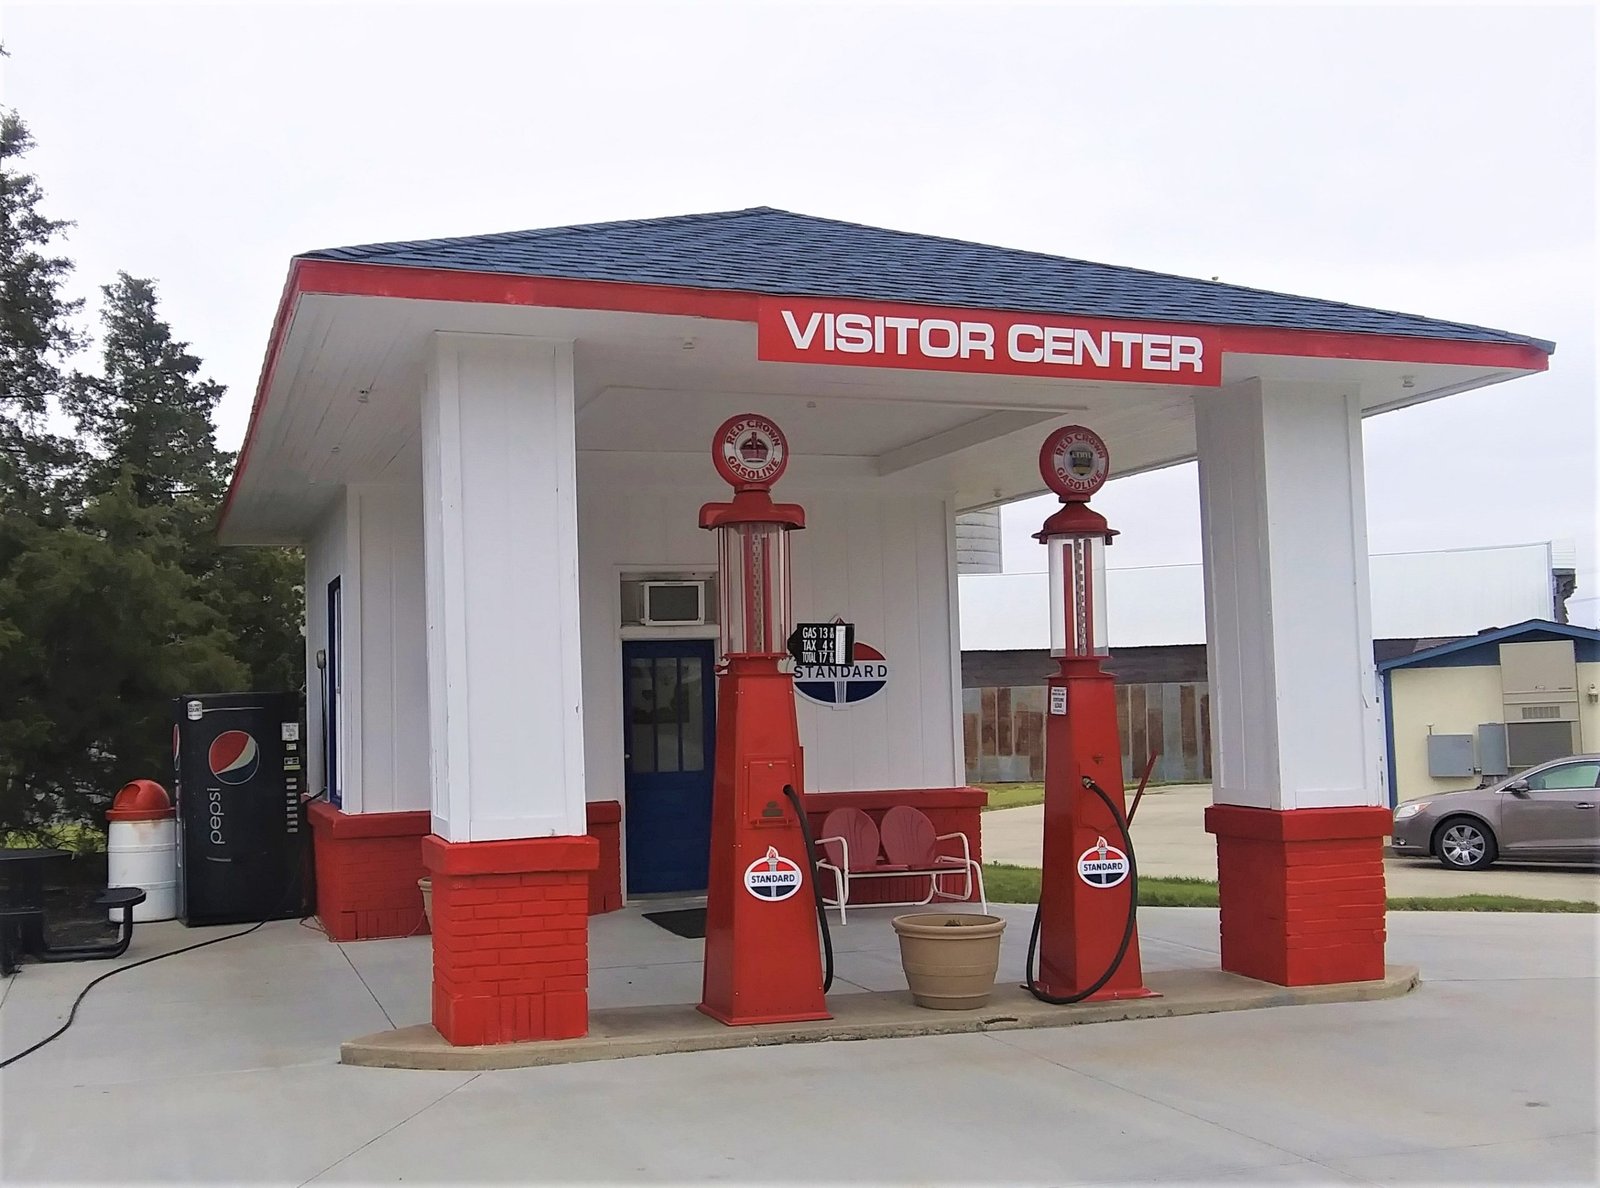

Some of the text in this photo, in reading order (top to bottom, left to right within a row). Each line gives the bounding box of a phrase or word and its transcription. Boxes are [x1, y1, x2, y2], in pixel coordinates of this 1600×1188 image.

[781, 310, 1204, 372] VISITOR CENTER
[726, 420, 780, 446] RED CROWN
[1055, 436, 1073, 456] RED
[728, 456, 780, 479] GASOLINE
[1057, 467, 1103, 489] GASOLINE
[802, 627, 817, 639] GAS
[819, 627, 828, 639] 13
[802, 639, 817, 651] TAX
[819, 651, 828, 663] 17
[793, 664, 888, 678] STANDARD
[207, 787, 226, 844] pepsi
[1083, 862, 1123, 872] STANDARD
[751, 874, 796, 883] STANDARD
